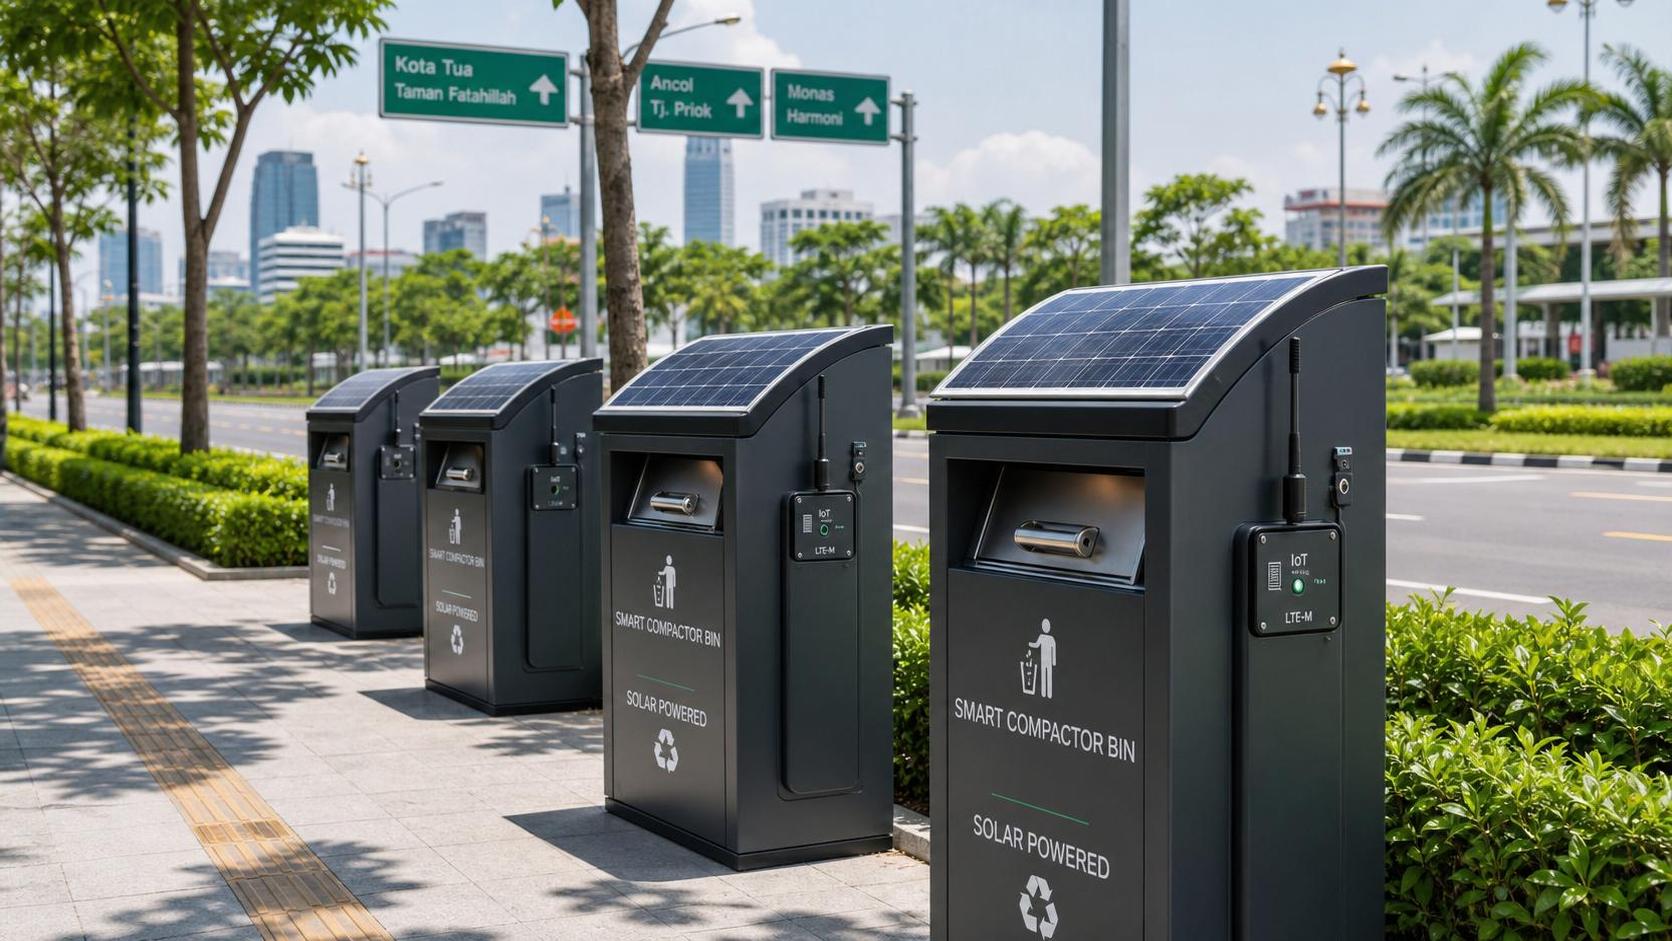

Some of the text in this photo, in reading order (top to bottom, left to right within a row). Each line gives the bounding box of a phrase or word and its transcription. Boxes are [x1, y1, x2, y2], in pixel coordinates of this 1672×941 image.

[395, 55, 474, 77] Kota Tua
[650, 75, 694, 92] Ancol
[788, 84, 835, 101] Monas
[395, 83, 517, 105] Taman Fatahillah
[650, 99, 712, 119] Tj. Priok
[787, 109, 843, 126] Harmoni
[819, 509, 831, 518] IoT
[1291, 553, 1308, 567] IoT
[1285, 611, 1313, 624] LTE-M
[615, 610, 721, 648] SMART COMPACTOR BIN
[626, 689, 708, 728] SOLAR POWERED
[954, 697, 1136, 763] SMART COMPACTOR BIN
[973, 814, 1110, 880] SOLAR POWERED
